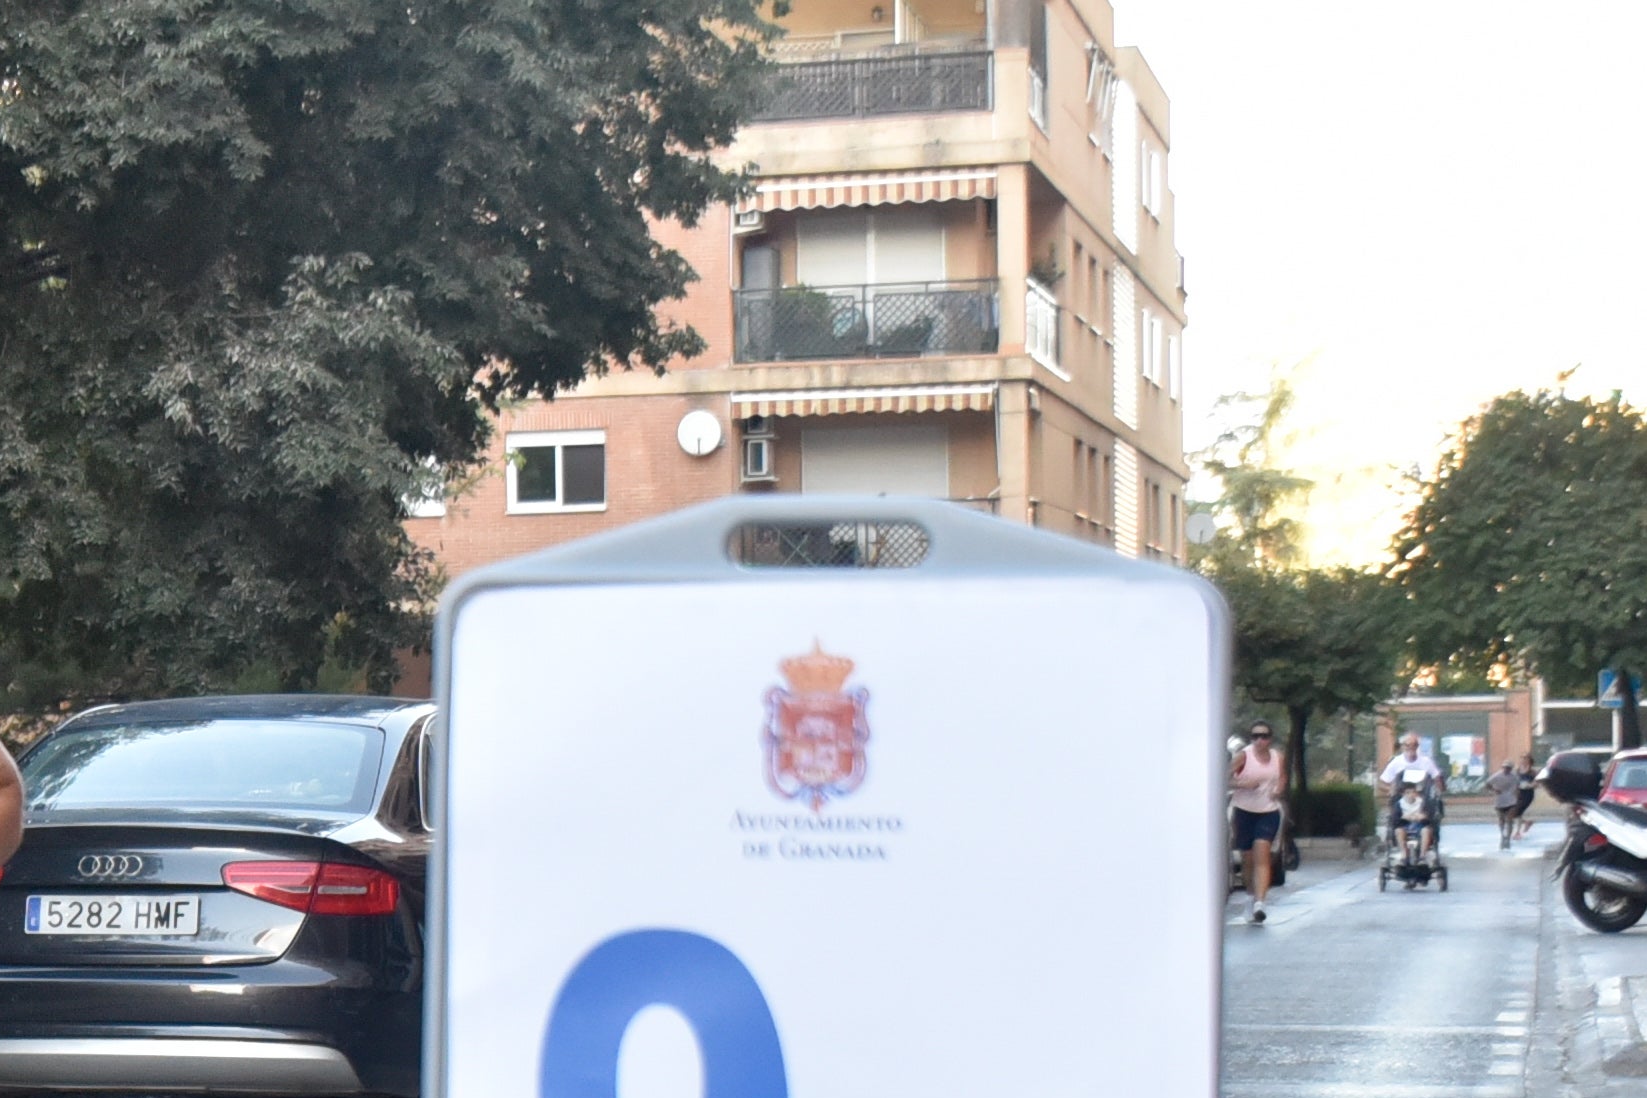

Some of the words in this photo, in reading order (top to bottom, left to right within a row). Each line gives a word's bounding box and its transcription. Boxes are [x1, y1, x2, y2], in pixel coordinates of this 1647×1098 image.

[730, 809, 903, 832] AYUNTAMIENTO
[779, 837, 888, 861] GRANADA
[47, 901, 122, 929] 5282
[134, 901, 190, 929] HMF
